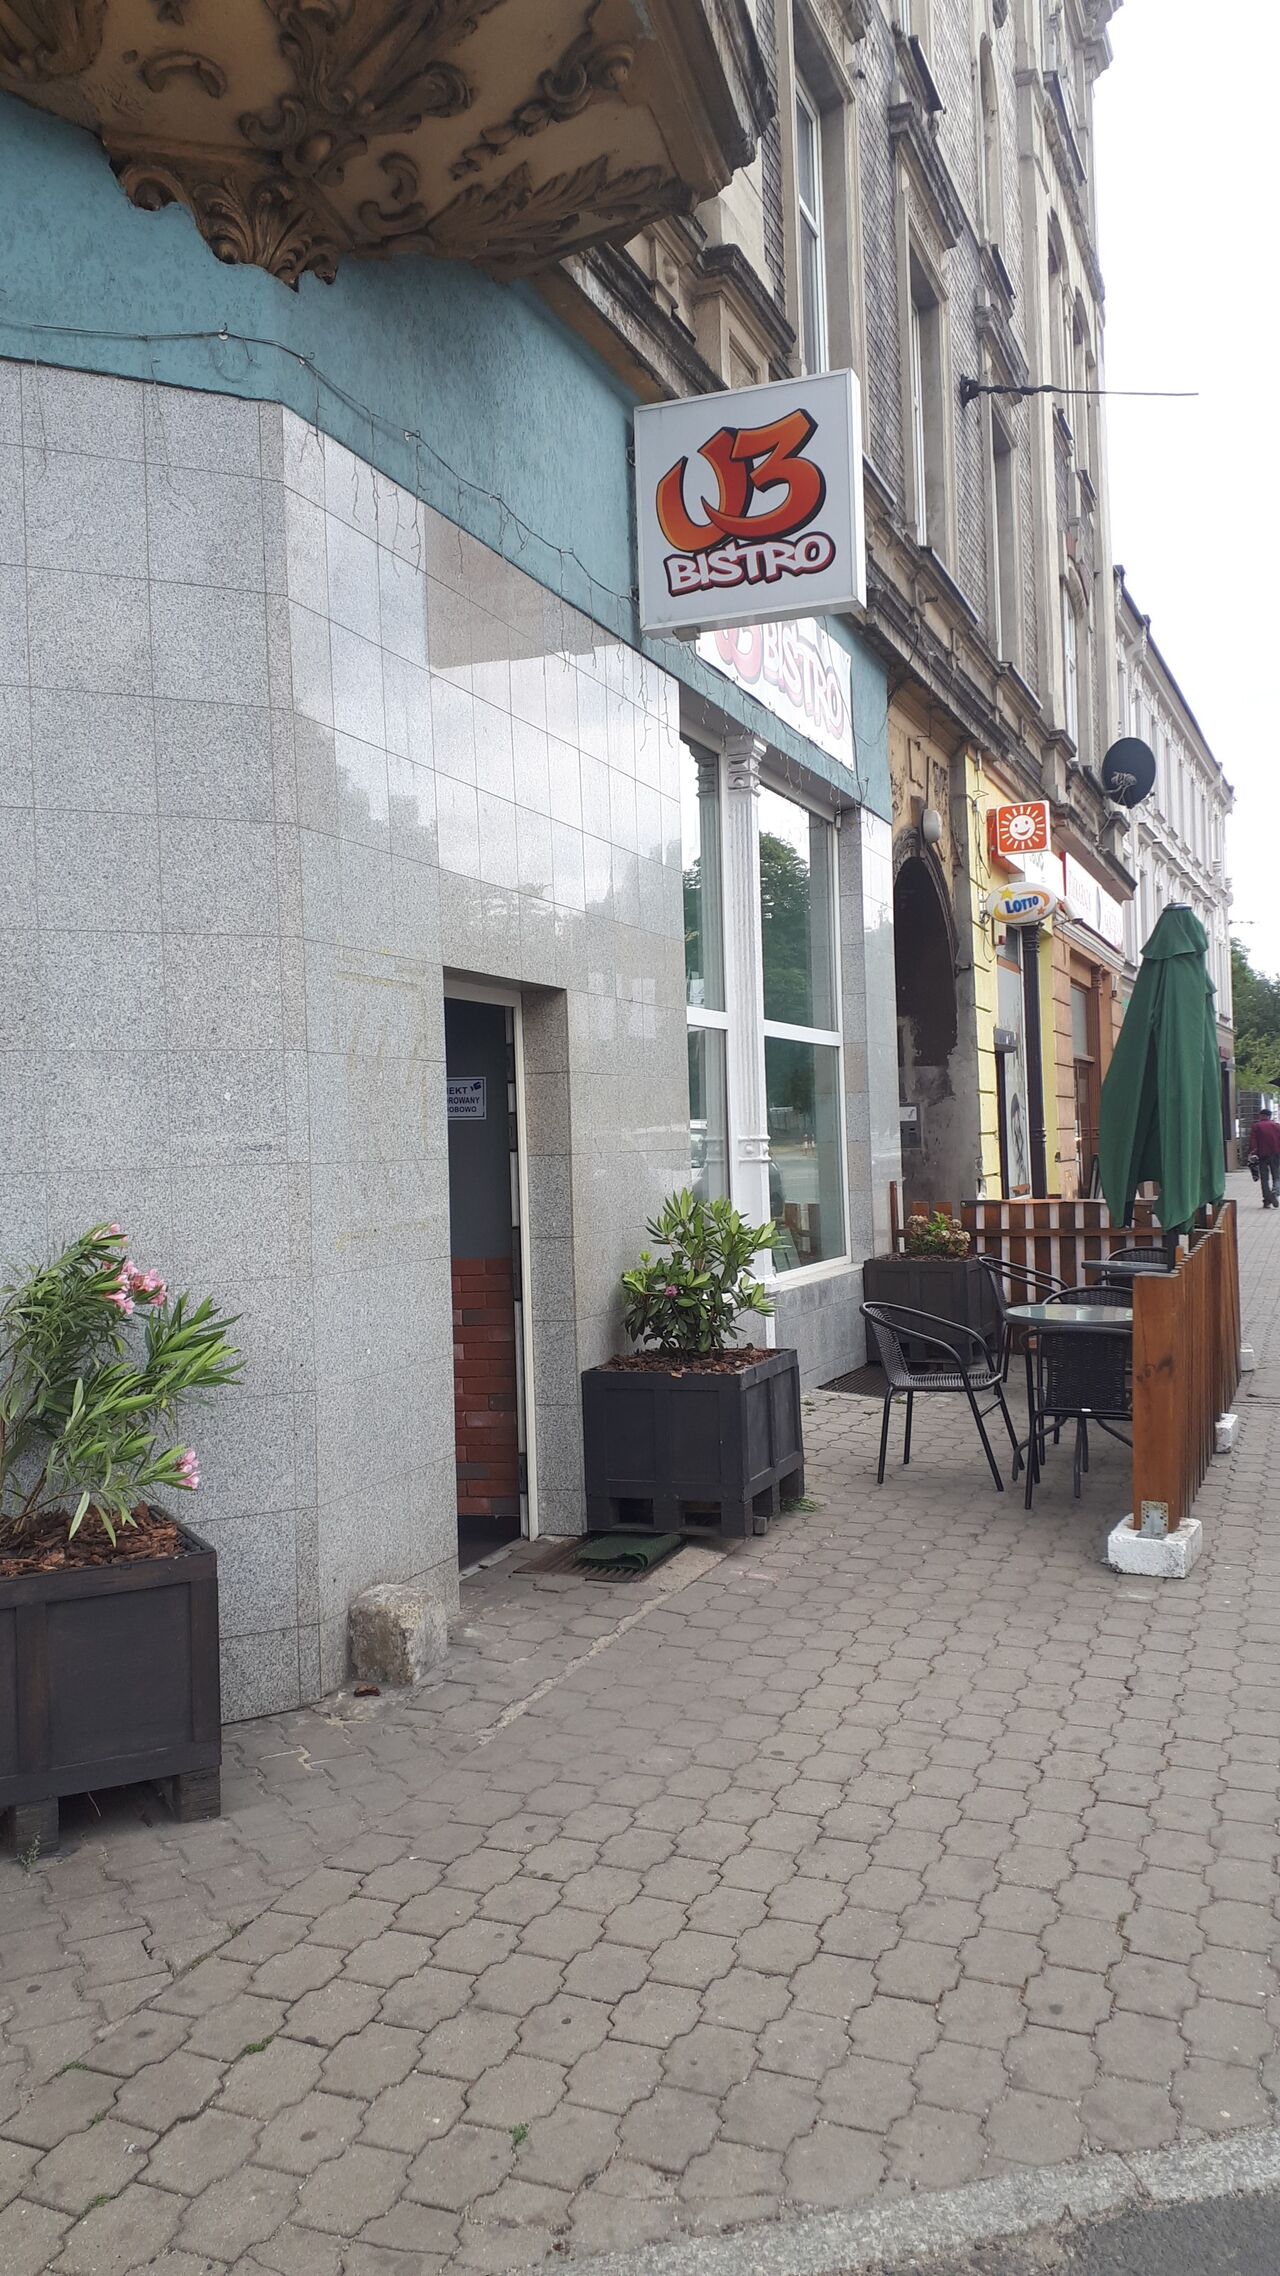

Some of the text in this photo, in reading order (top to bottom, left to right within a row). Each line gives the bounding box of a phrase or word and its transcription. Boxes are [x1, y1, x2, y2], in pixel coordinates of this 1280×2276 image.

[663, 531, 836, 597] BISTRO
[762, 621, 844, 740] BISTRO
[1005, 895, 1039, 914] LOTTO
[448, 1096, 480, 1105] ROWANY
